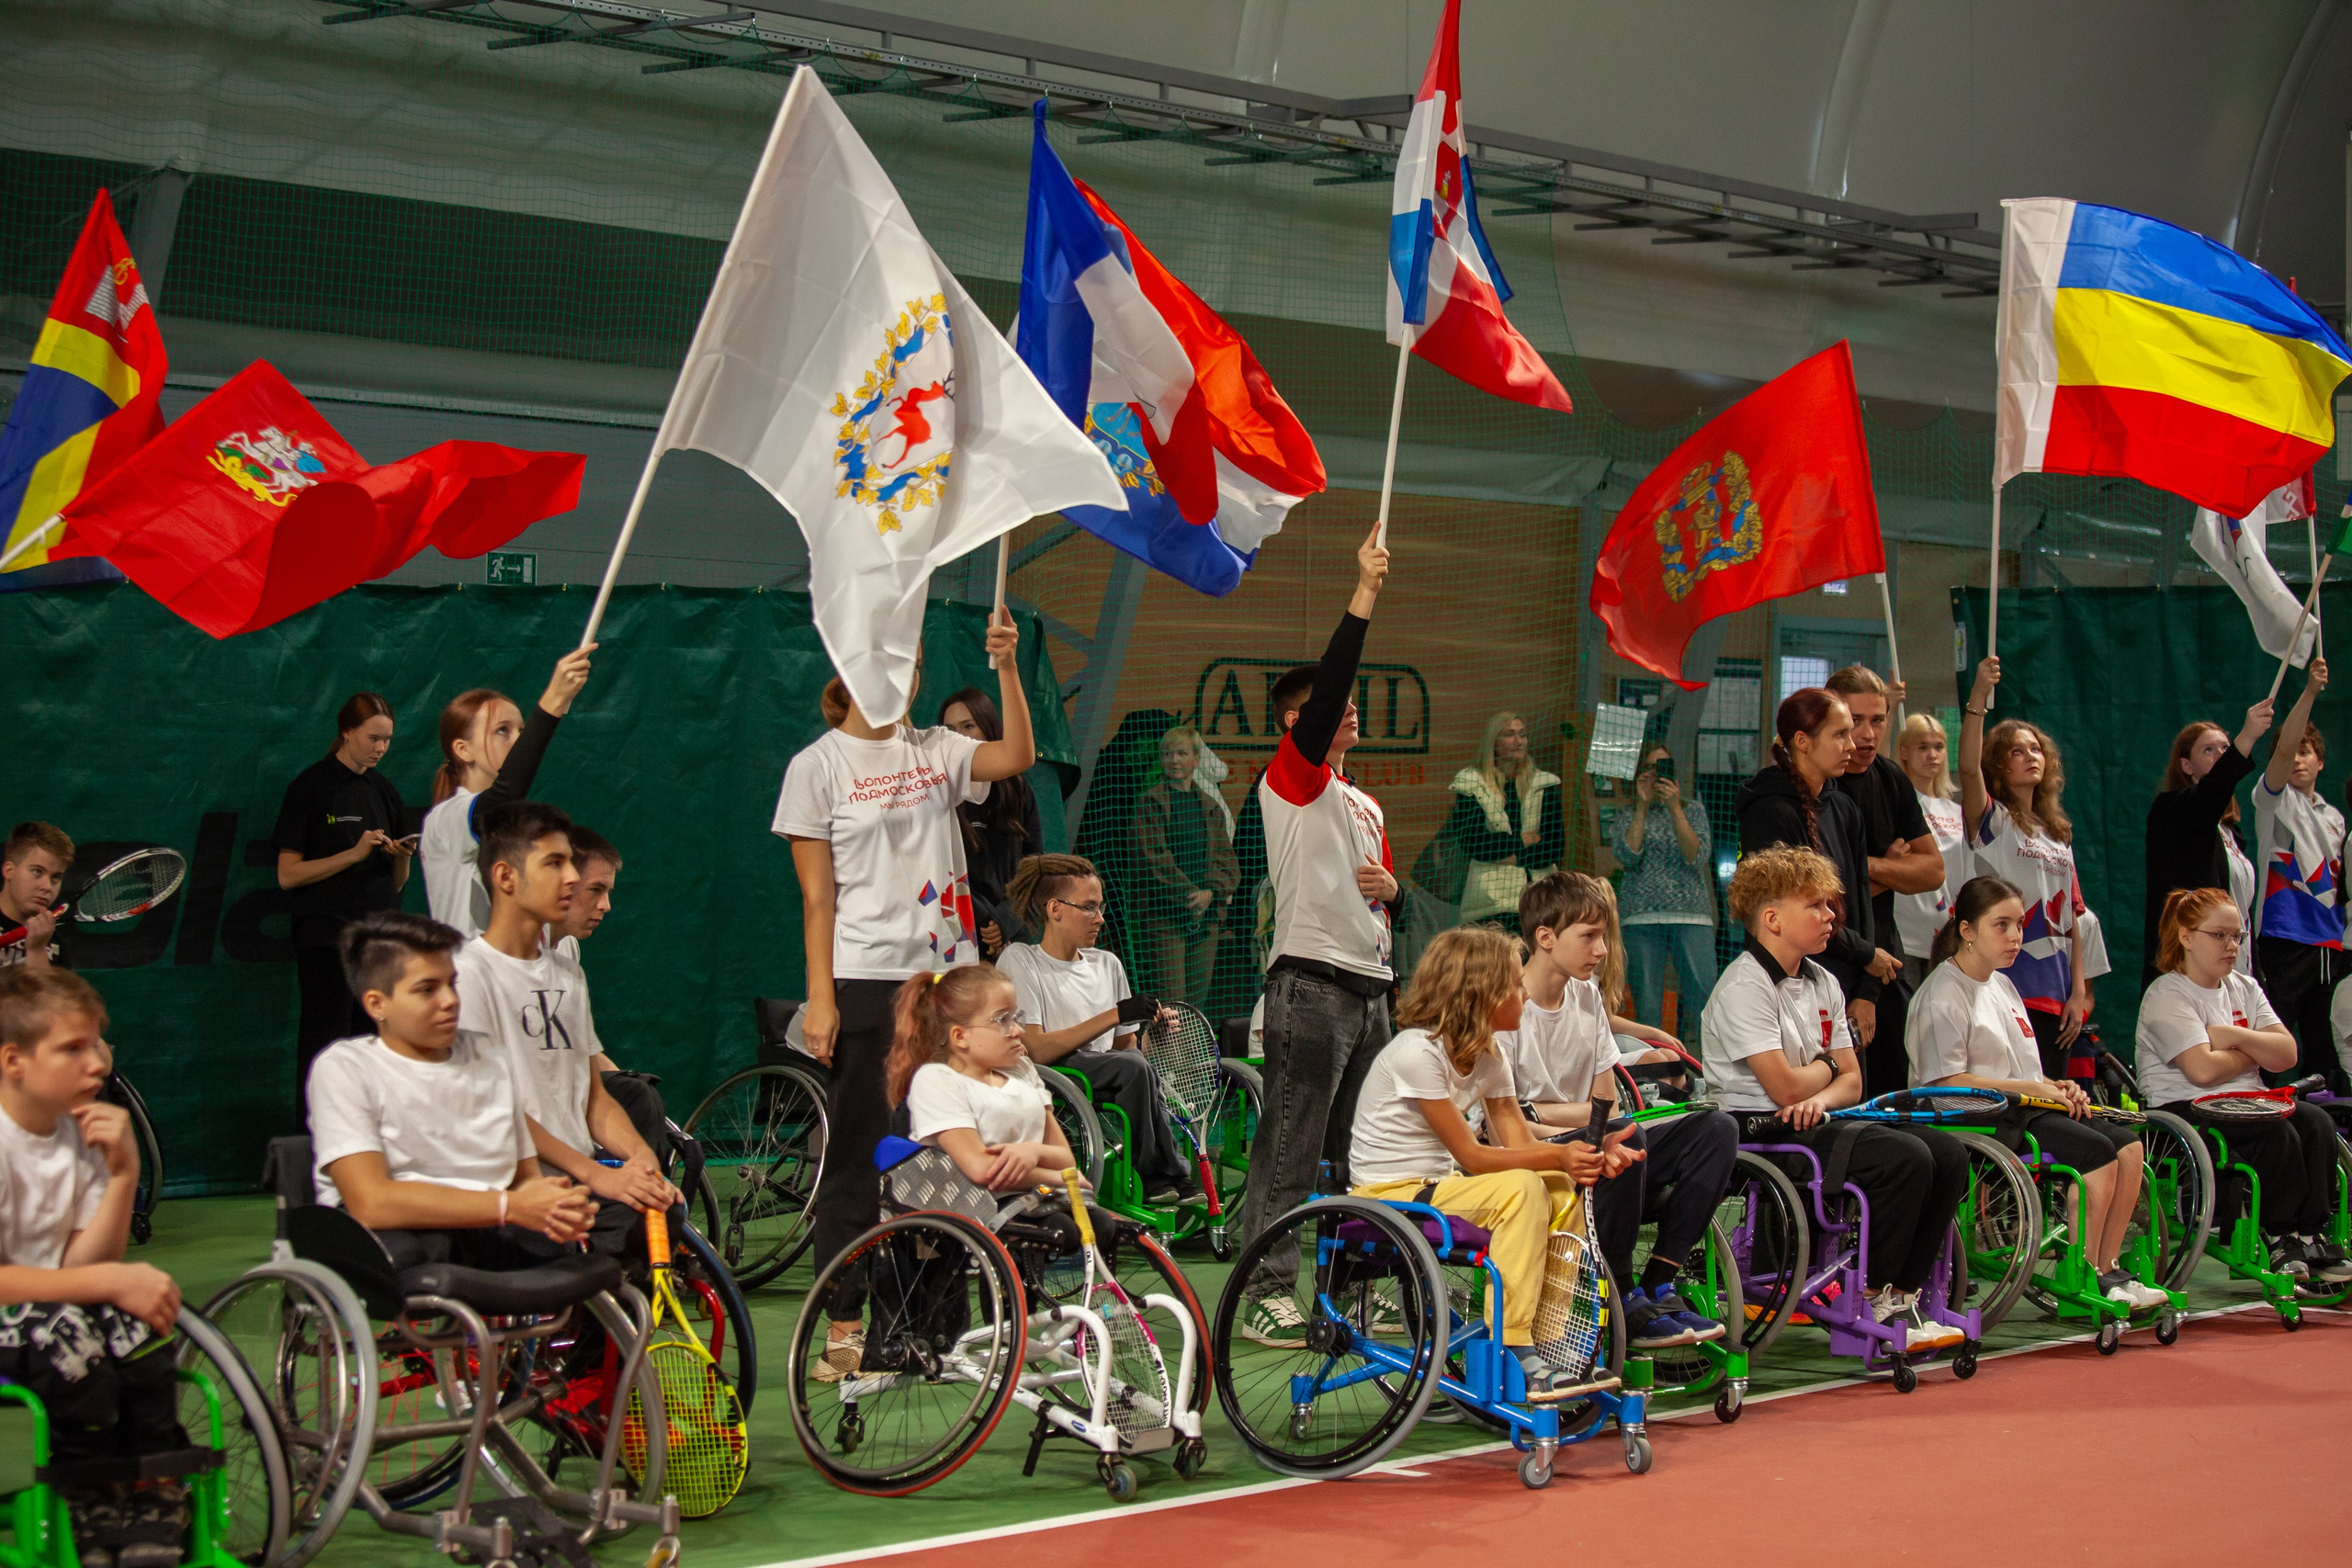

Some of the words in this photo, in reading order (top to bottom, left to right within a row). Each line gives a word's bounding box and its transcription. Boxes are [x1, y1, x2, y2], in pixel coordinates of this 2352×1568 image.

[1204, 669, 1419, 739] AIL
[848, 773, 947, 806] ПОДМОСКОВЬЯ
[895, 793, 930, 809] РЯДОМ
